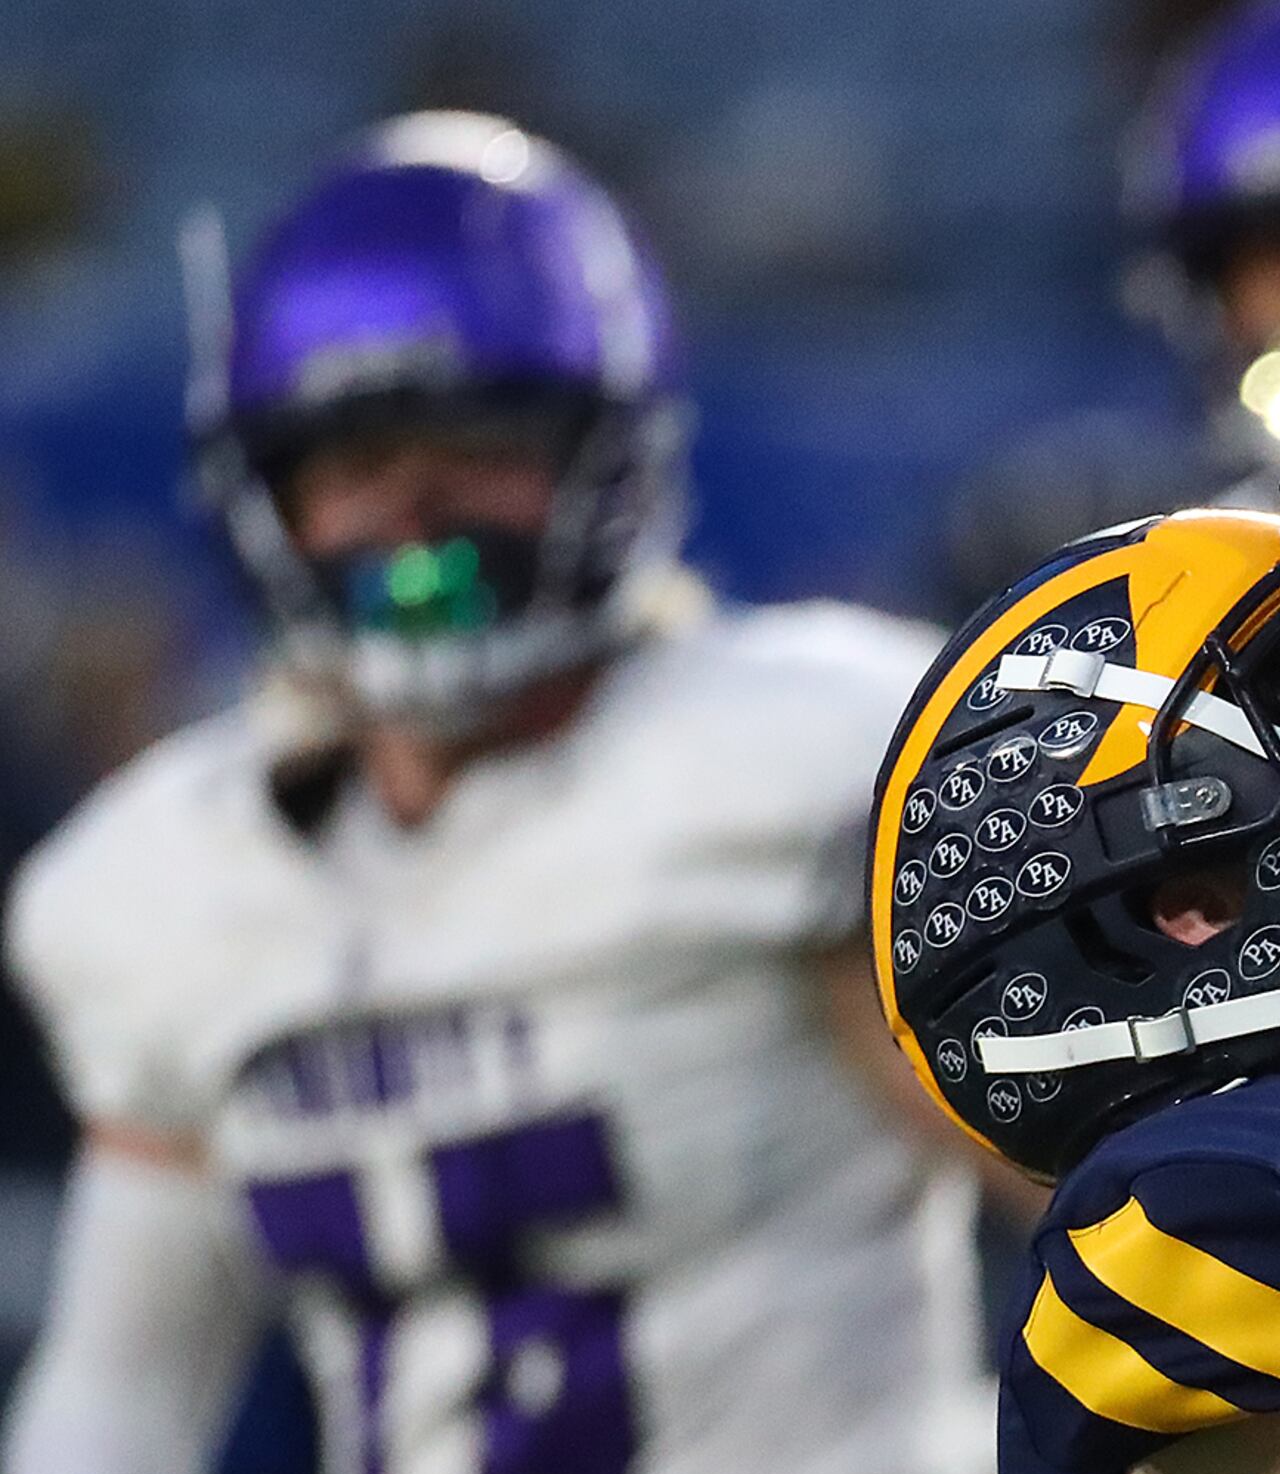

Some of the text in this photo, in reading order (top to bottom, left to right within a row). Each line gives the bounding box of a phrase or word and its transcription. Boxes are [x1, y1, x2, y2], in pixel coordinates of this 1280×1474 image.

[1028, 632, 1055, 654] PA
[1088, 624, 1118, 648] PA
[1055, 719, 1084, 740] PA
[999, 747, 1029, 772] PA
[950, 775, 976, 803] PA
[909, 798, 930, 824] PA
[1040, 792, 1075, 819] PA
[986, 816, 1017, 844] PA
[937, 842, 966, 870] PA
[900, 870, 922, 895] PA
[1027, 861, 1063, 888] PA
[976, 886, 1007, 913] PA
[932, 912, 960, 938] PA
[897, 939, 919, 965] PA
[1007, 984, 1043, 1009] PA
[1187, 982, 1227, 1007] PA
